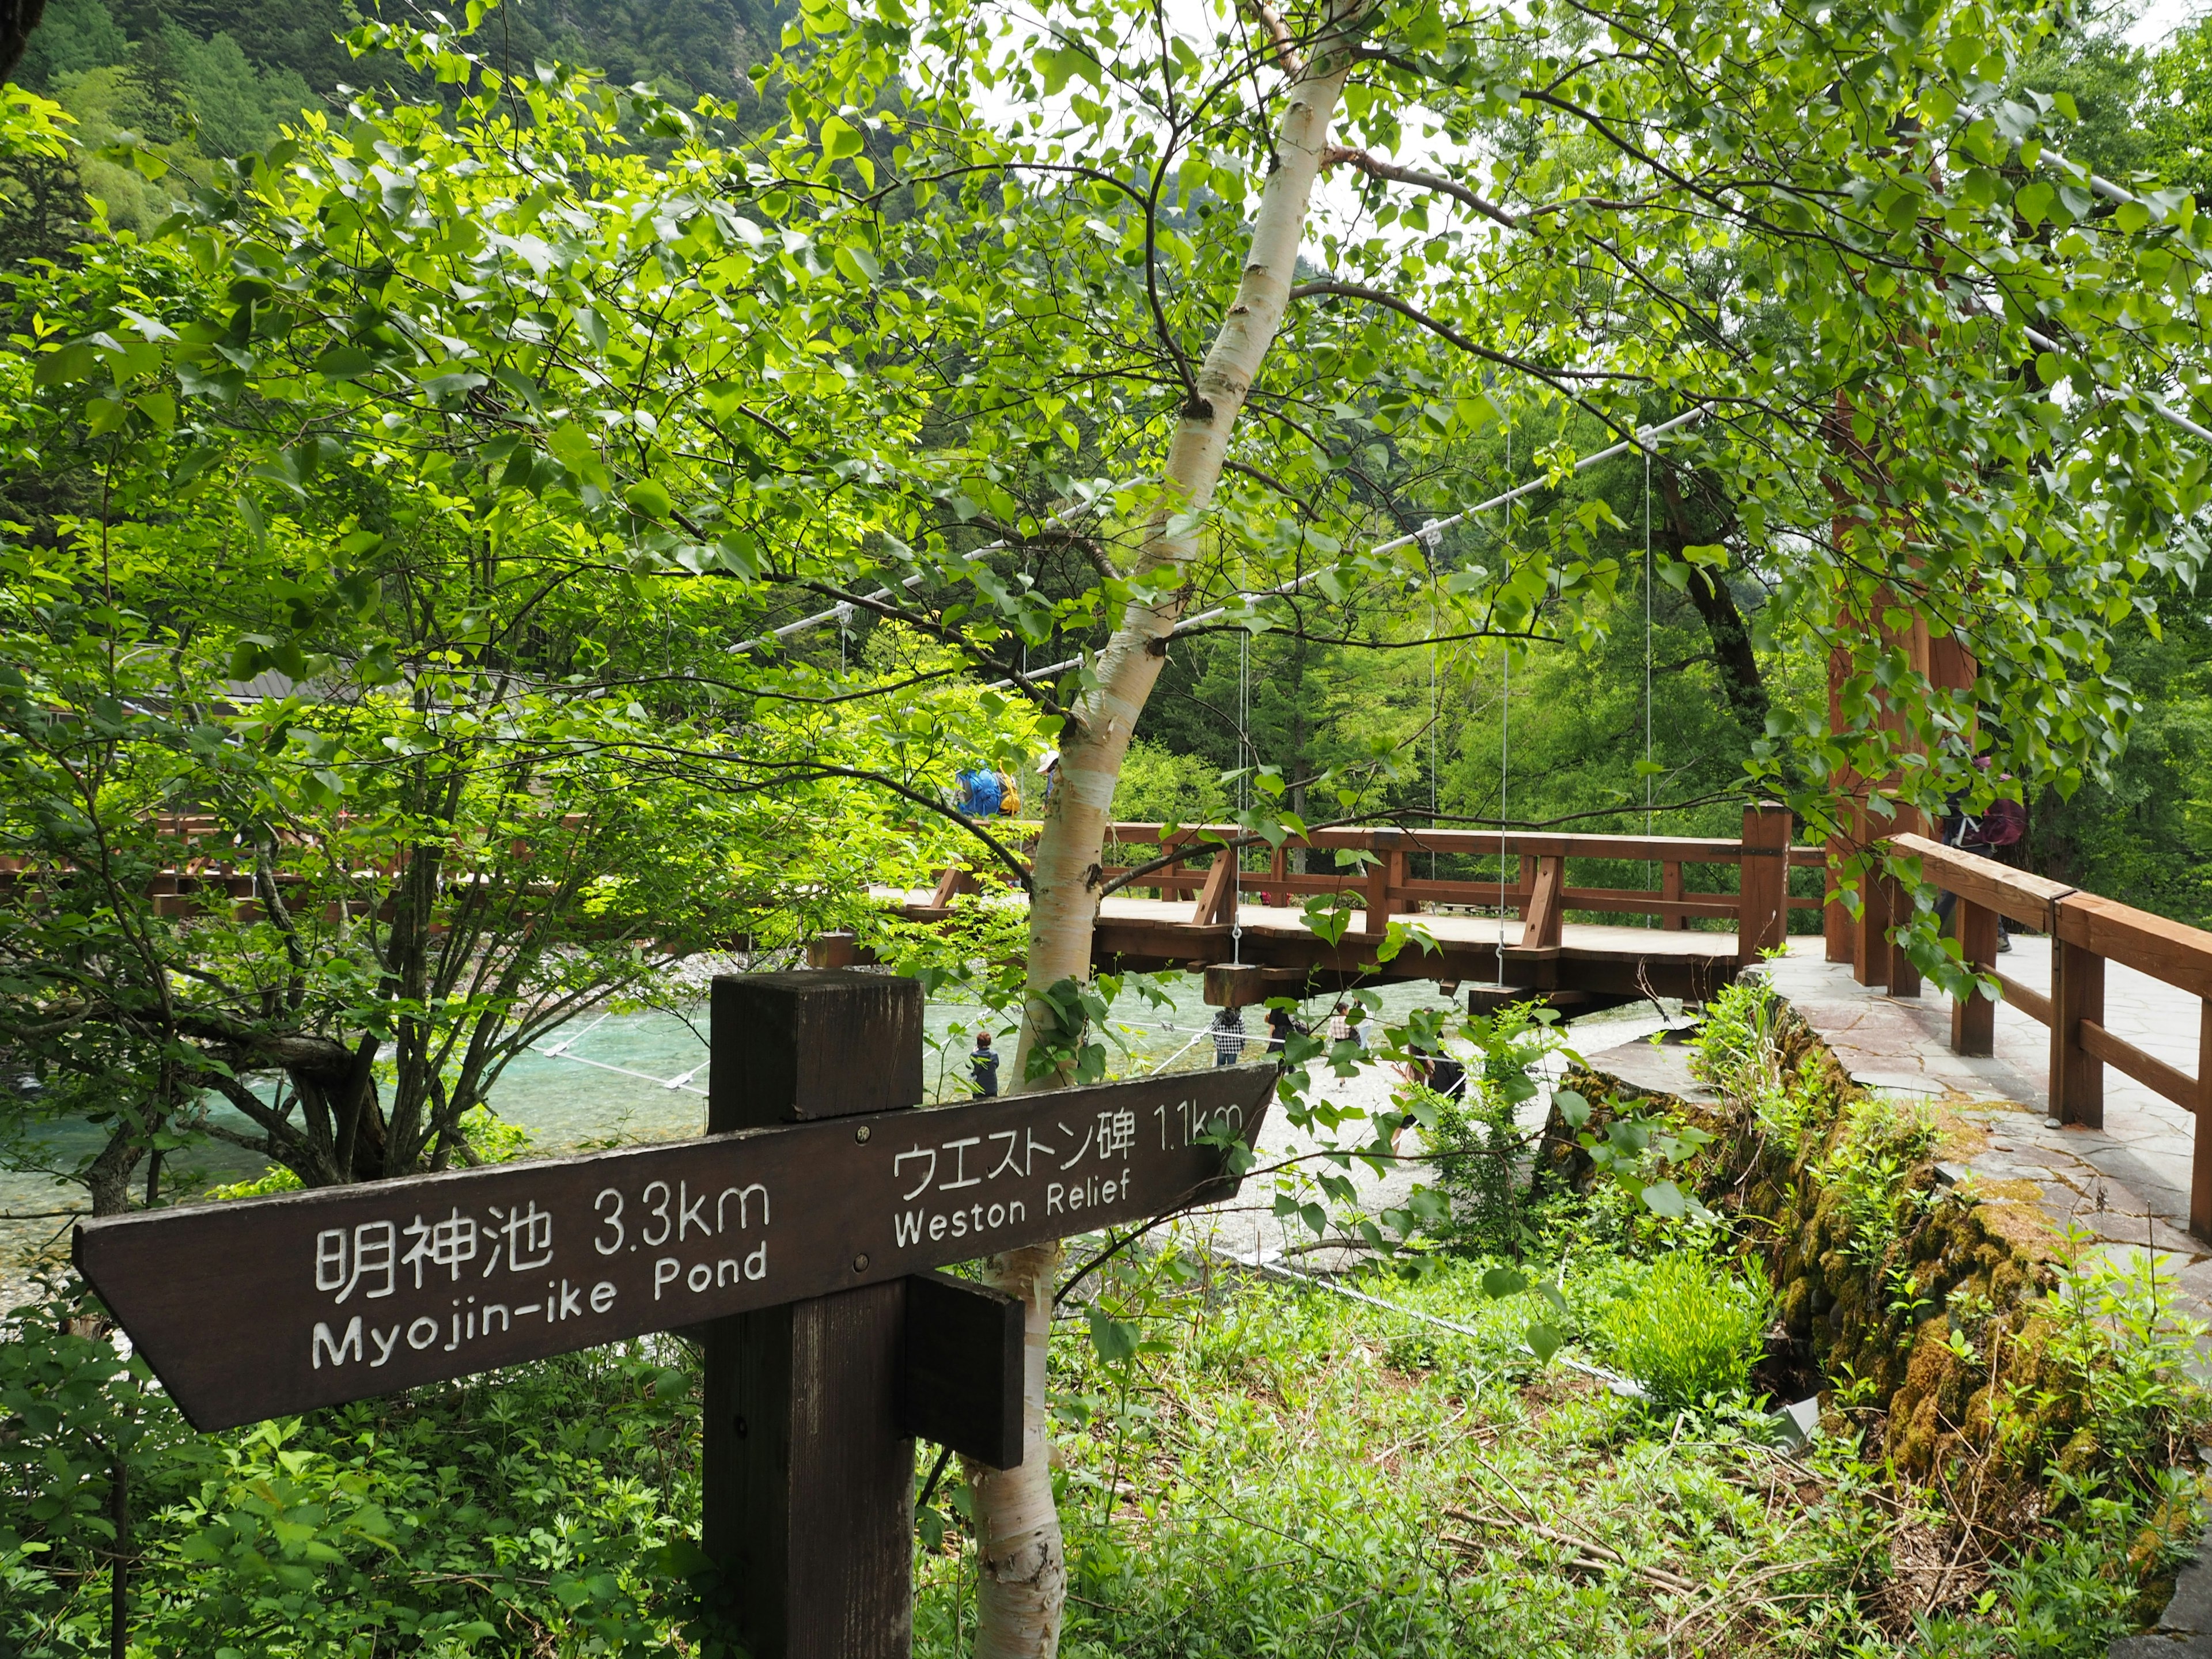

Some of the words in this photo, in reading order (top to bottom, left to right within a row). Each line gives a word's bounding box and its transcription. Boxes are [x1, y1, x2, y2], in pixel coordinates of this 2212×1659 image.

[893, 1106, 1136, 1201] ウエストン碑
[1153, 1099, 1243, 1151] 1.1km
[316, 1200, 554, 1304] 明神池
[594, 1180, 770, 1255] 3.3km
[894, 1200, 1025, 1248] Weston
[1047, 1168, 1131, 1216] Relief
[312, 1278, 618, 1369] Myojin-ike
[654, 1240, 767, 1301] Pond
